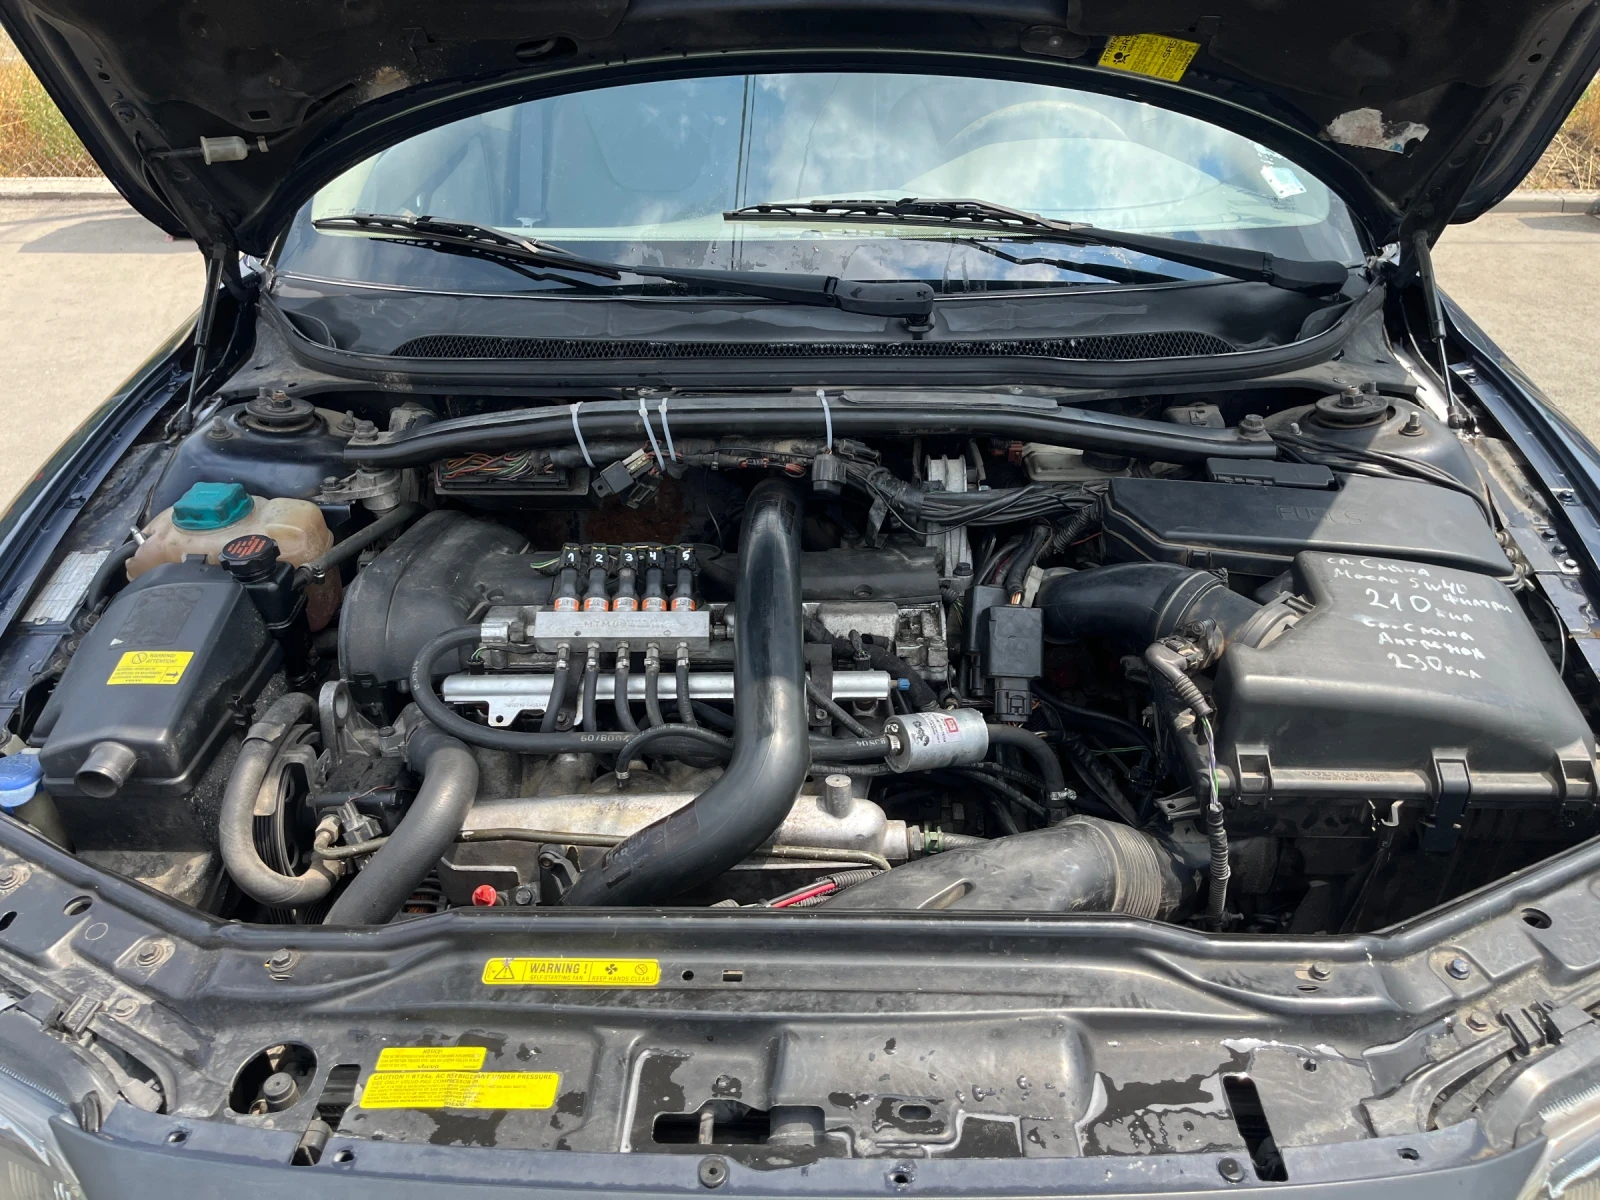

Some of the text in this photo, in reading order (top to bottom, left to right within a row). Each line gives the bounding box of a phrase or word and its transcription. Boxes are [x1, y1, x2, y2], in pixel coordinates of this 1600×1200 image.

[1162, 40, 1178, 59] SRS
[567, 553, 575, 562] 1
[595, 554, 604, 563] 2
[625, 553, 634, 562] 3
[649, 551, 657, 561] 4
[682, 550, 691, 561] 5
[1365, 587, 1432, 613] 210
[1387, 652, 1442, 672] 230
[530, 963, 580, 973] WARNING
